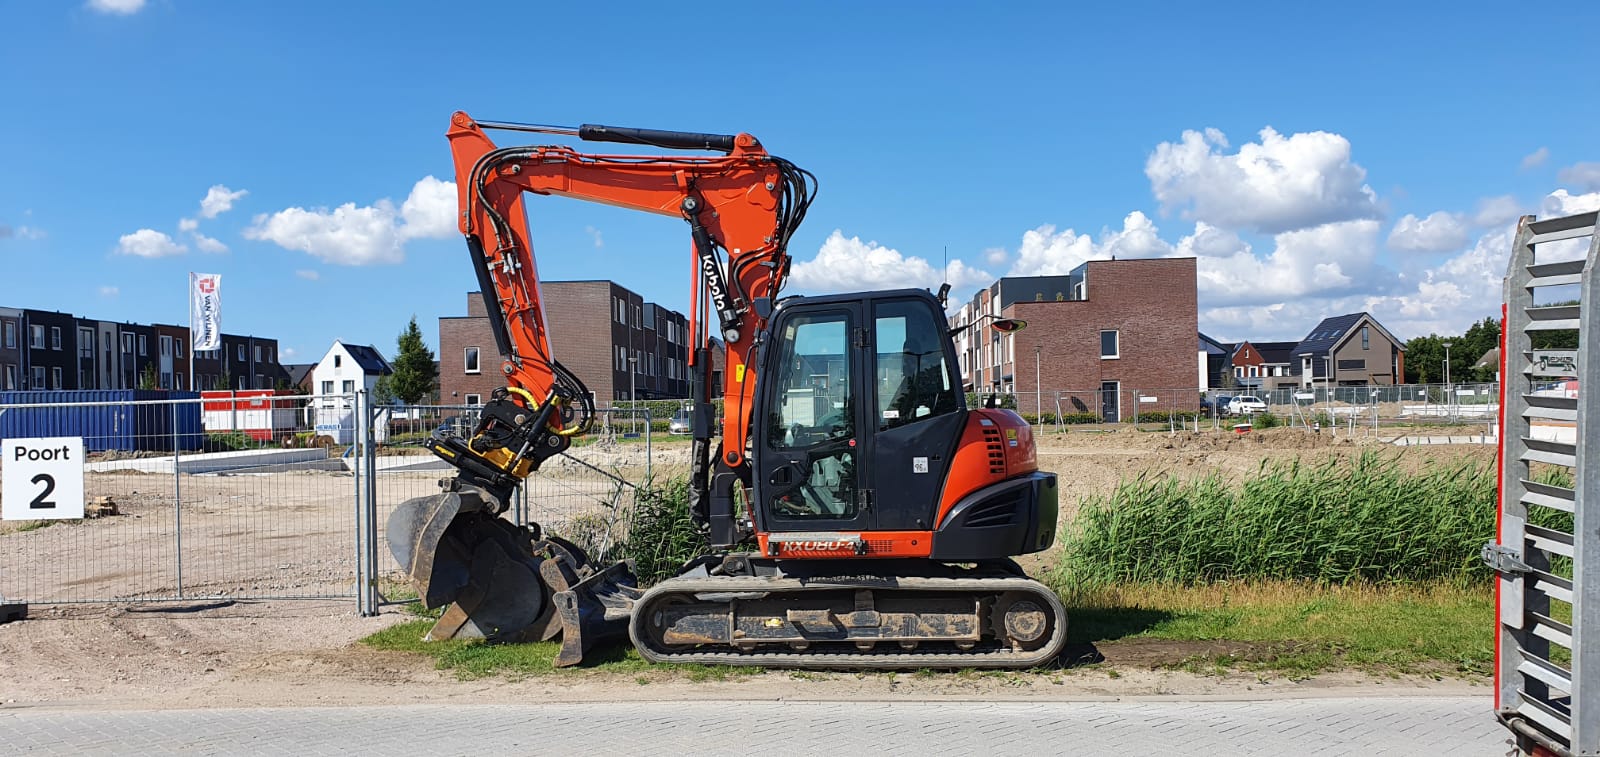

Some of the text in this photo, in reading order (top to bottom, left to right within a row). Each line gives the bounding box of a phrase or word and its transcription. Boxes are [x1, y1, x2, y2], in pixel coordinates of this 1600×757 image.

[702, 254, 725, 311] Kubota
[204, 295, 213, 347] VAN WIJNEN
[15, 445, 70, 461] Poort
[29, 473, 56, 509] 2
